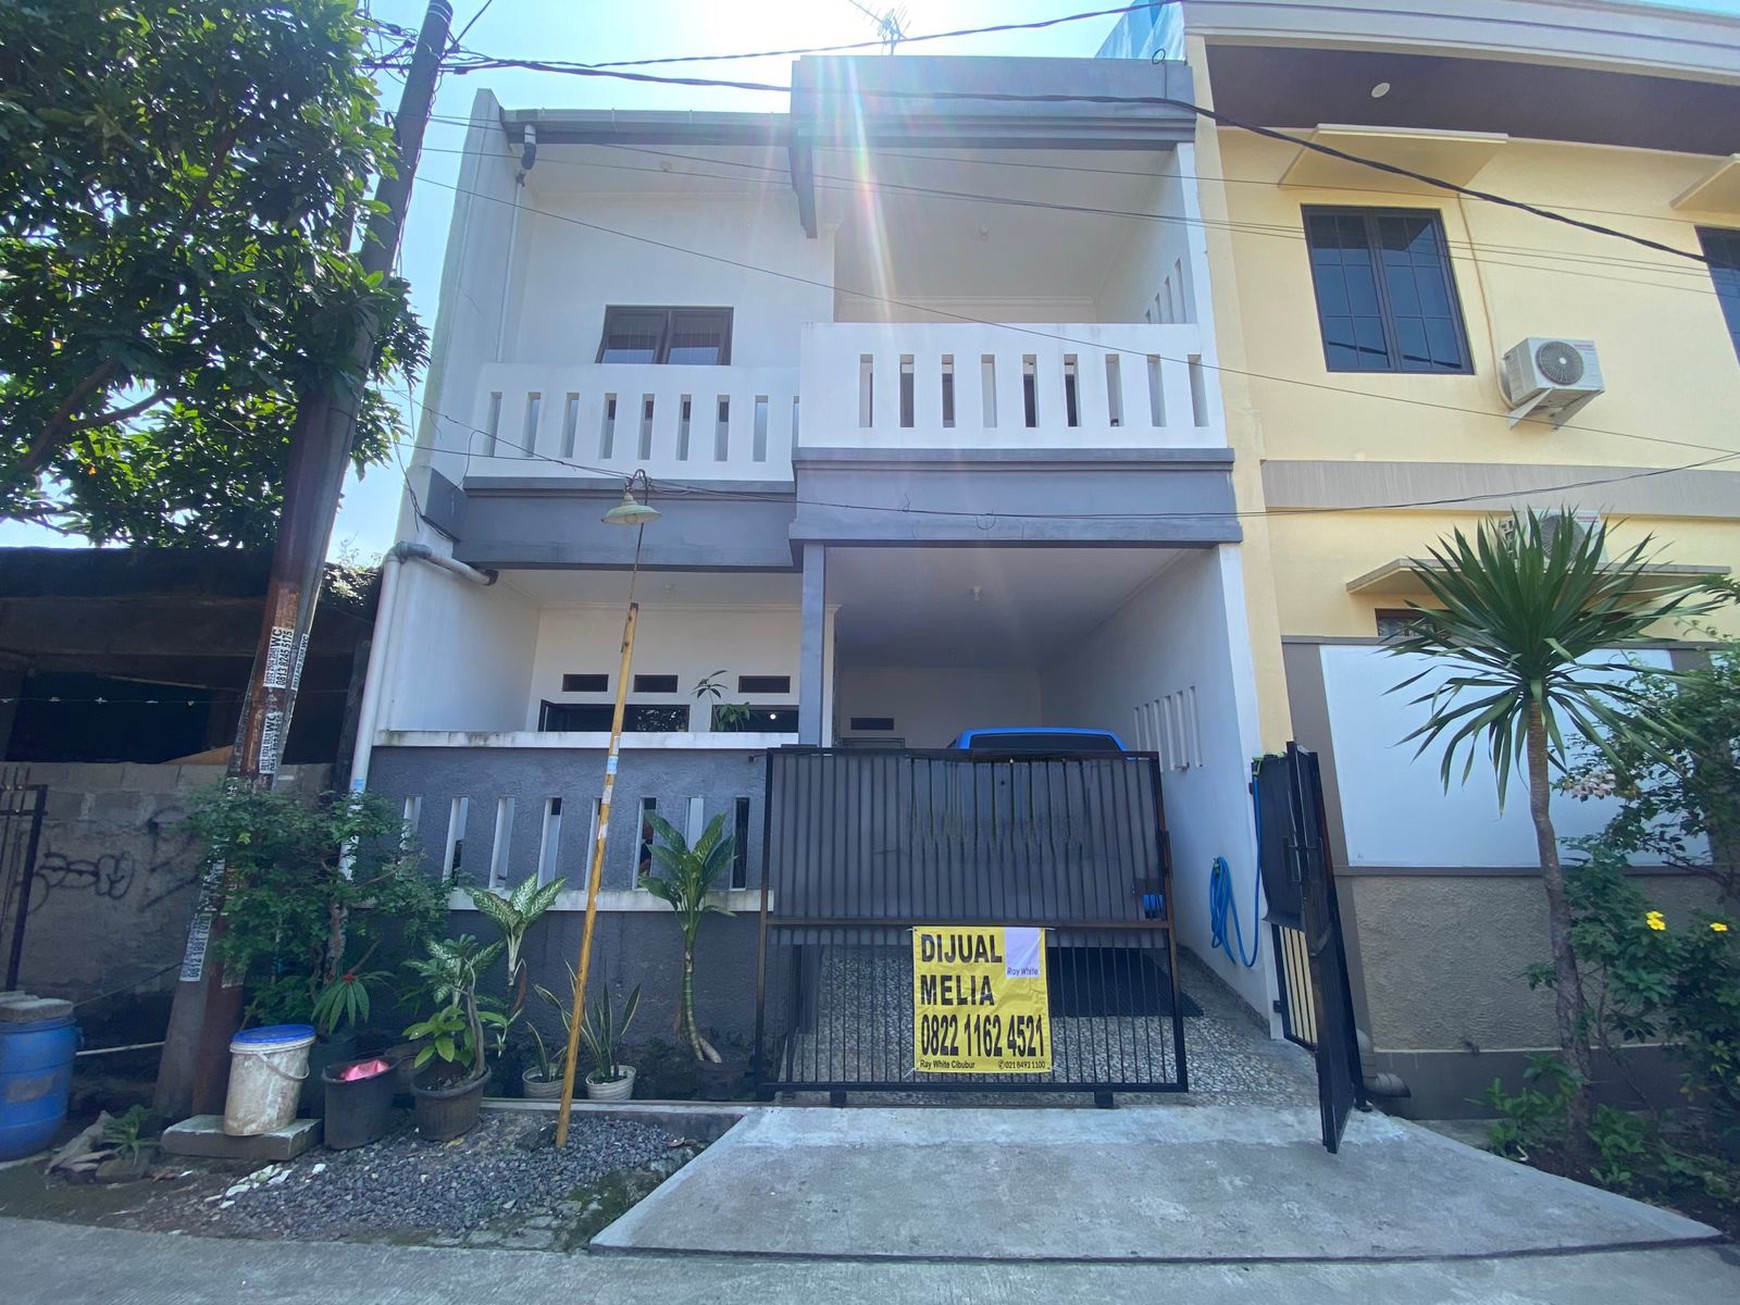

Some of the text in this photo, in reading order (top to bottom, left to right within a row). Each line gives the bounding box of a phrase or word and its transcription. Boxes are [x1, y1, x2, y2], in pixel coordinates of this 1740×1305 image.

[271, 628, 283, 646] WC
[921, 934, 1003, 963] DIJUAL
[1007, 966, 1039, 976] Ray White
[920, 974, 995, 1006] MELIA
[921, 1014, 1045, 1058] 0822 1162 4521
[919, 1059, 976, 1070] Ray White Cibubur
